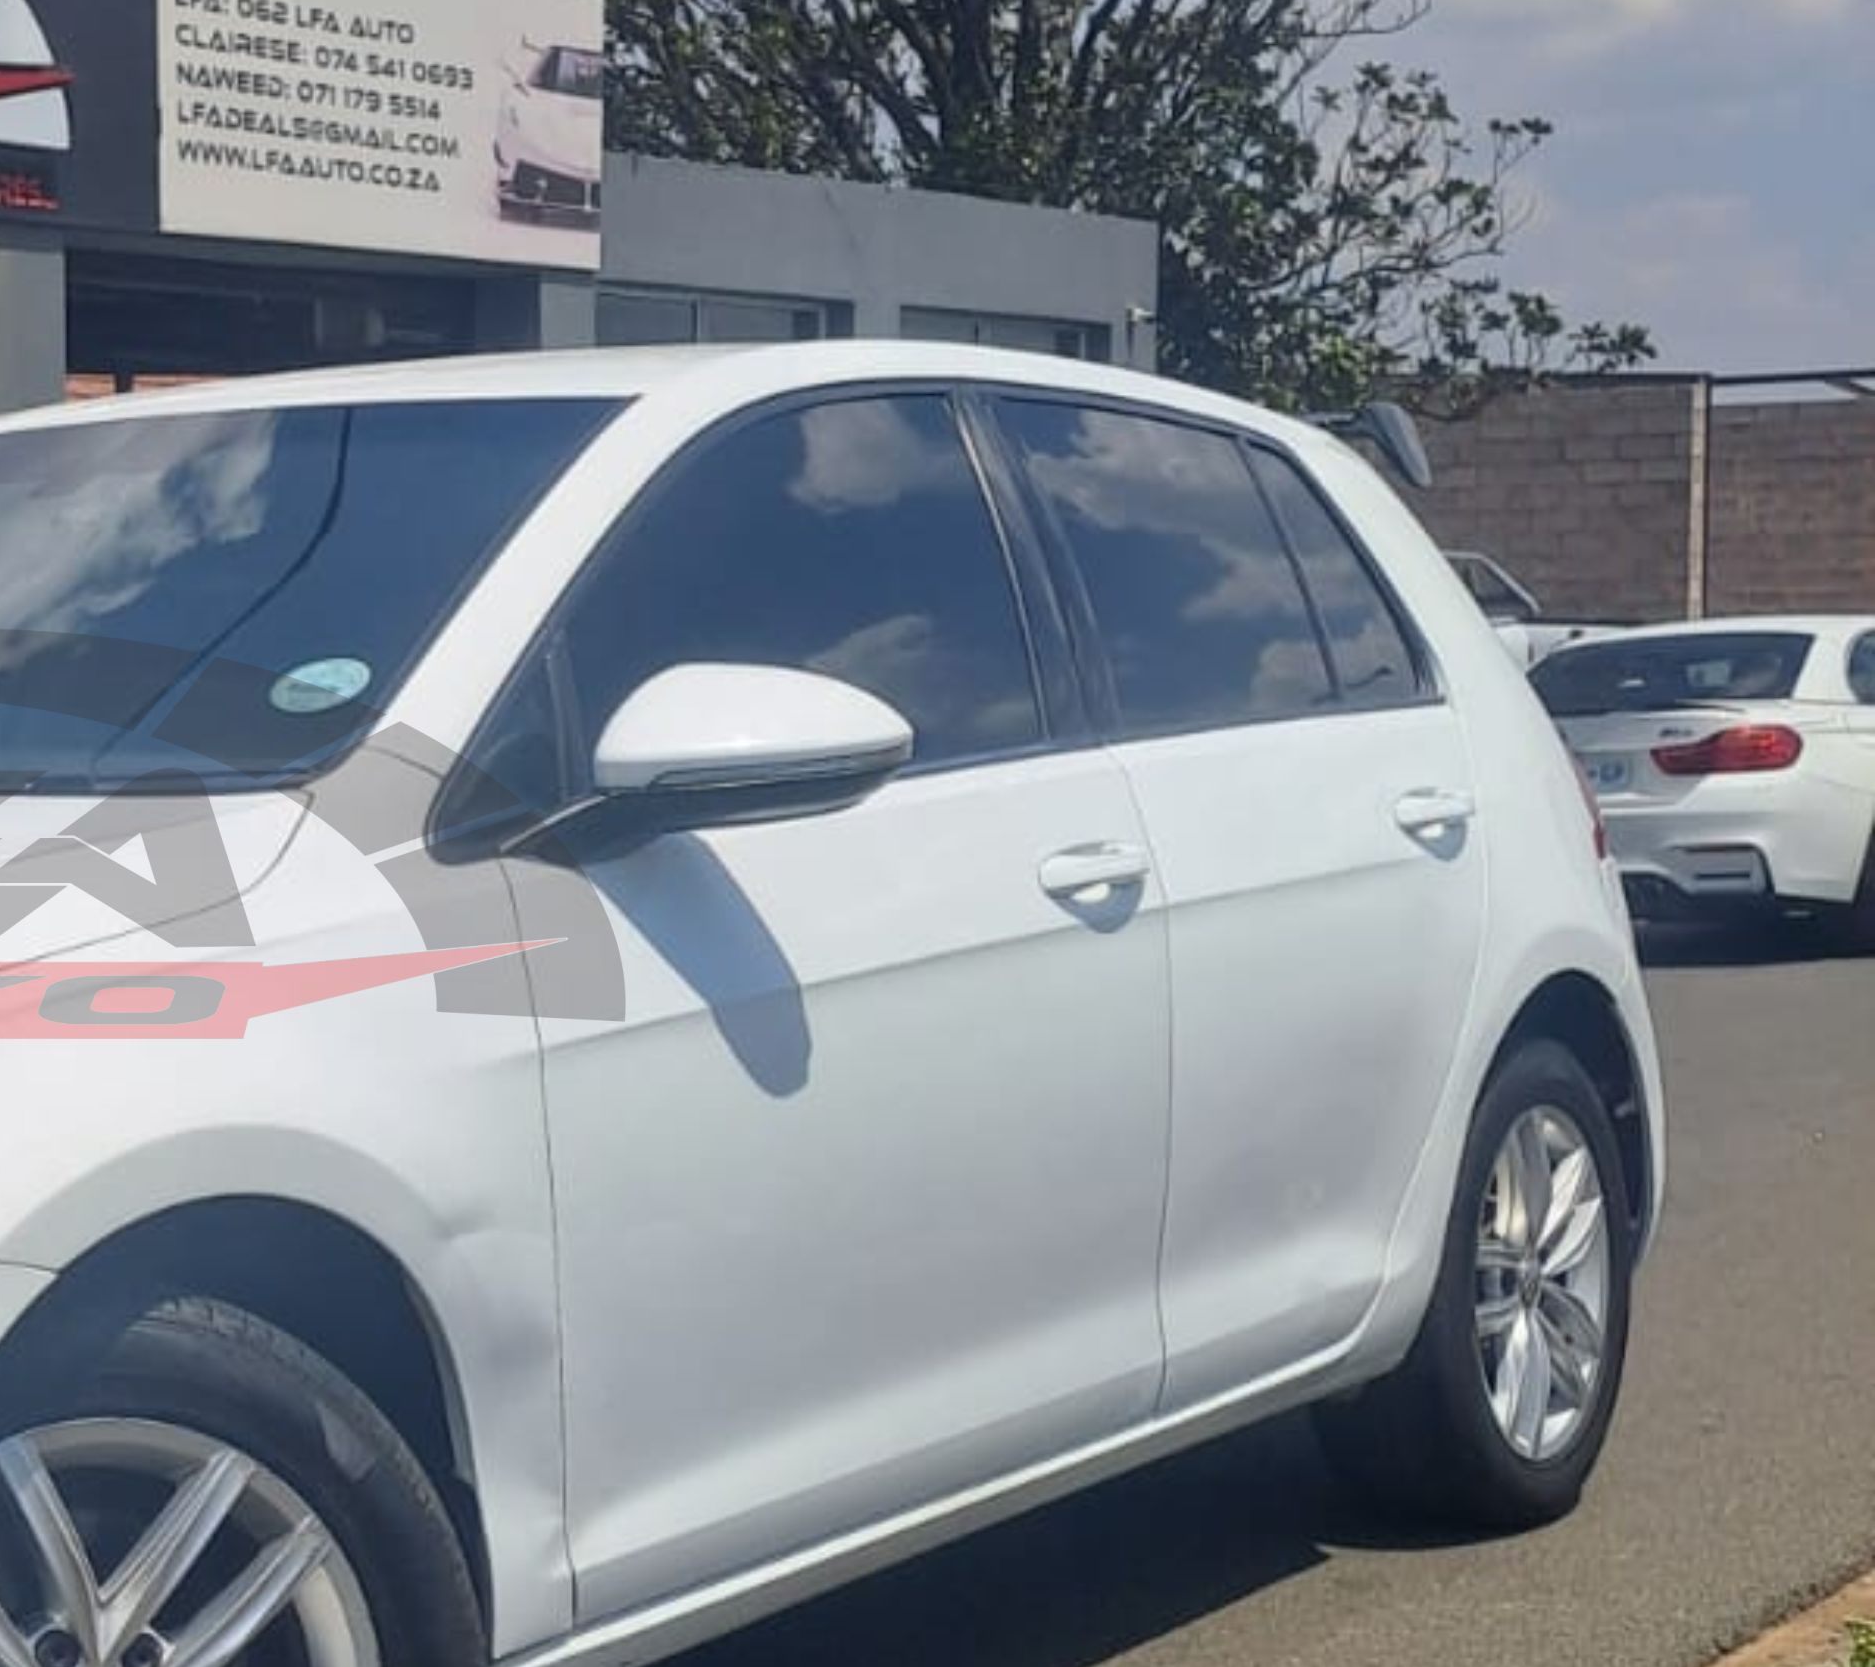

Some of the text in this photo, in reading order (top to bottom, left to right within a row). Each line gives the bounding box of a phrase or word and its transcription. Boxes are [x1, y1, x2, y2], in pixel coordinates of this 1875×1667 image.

[295, 4, 341, 34] LFA
[350, 16, 414, 44] AUTO
[315, 44, 358, 72] 074
[366, 53, 405, 80] 541
[296, 79, 337, 107] 071
